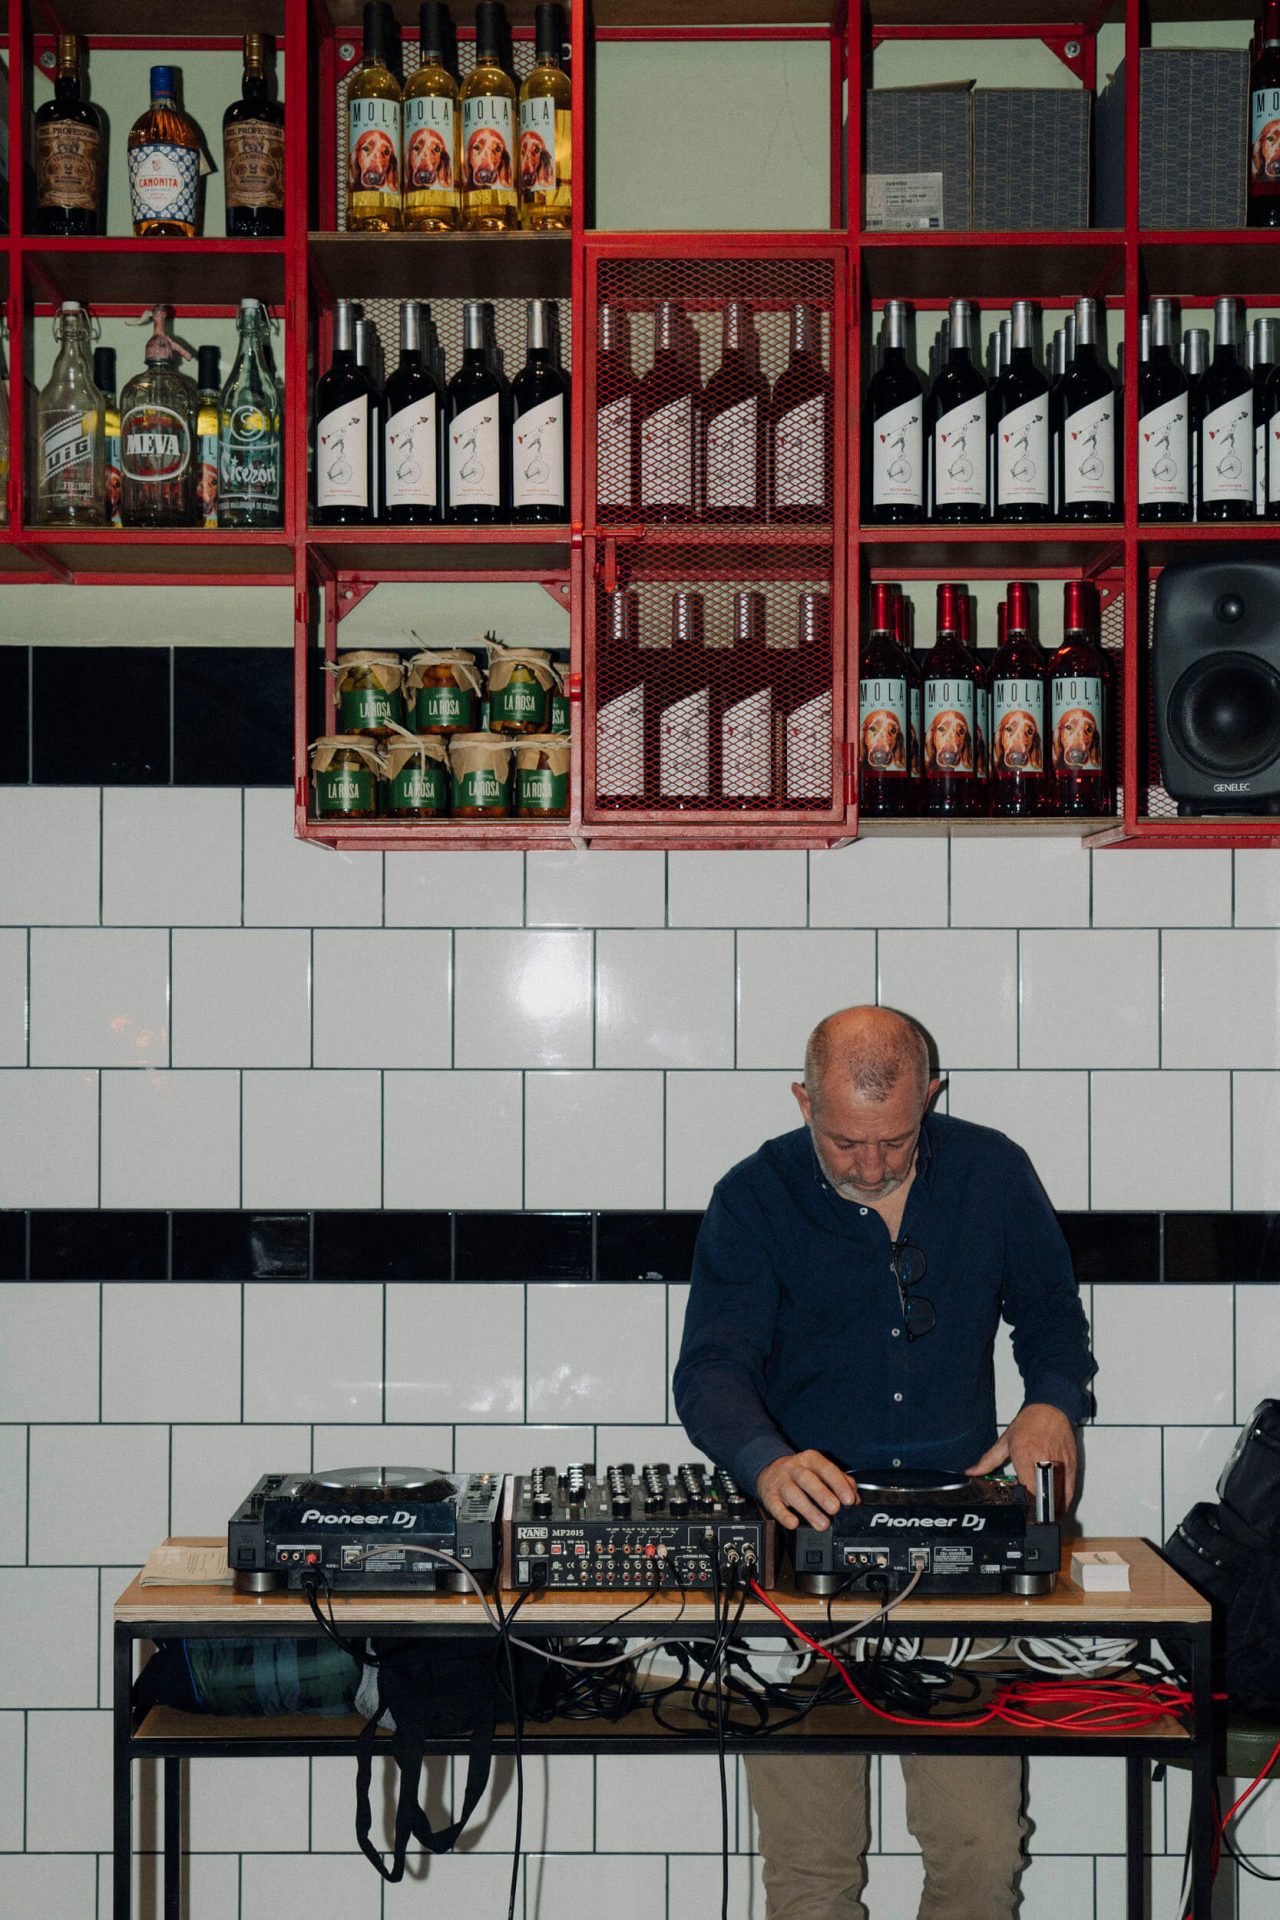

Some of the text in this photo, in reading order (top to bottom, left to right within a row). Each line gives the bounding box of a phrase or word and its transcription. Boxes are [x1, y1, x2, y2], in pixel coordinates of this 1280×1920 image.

[1256, 92, 1279, 113] MO
[353, 101, 399, 126] MOLA
[406, 100, 450, 123] MOLA
[464, 100, 509, 123] MOLA
[521, 101, 550, 125] OLA
[126, 433, 182, 456] MEVA
[860, 682, 904, 702] MOLA
[928, 682, 972, 703] MOLA
[996, 682, 1041, 703] MOLA
[1055, 681, 1100, 701] MOLA
[360, 702, 391, 718] LA ROSA
[428, 700, 460, 716] LA ROSA
[504, 695, 535, 711] LA ROSA
[328, 783, 360, 799] LA ROSA
[403, 782, 413, 797] LA
[469, 781, 500, 797] LA ROSA
[523, 782, 552, 798] LA ROSA
[1213, 783, 1250, 793] GENELEC
[301, 1509, 388, 1525] Pioneer
[870, 1513, 957, 1527] Pioneer
[517, 1527, 584, 1539] RANE MP2015
